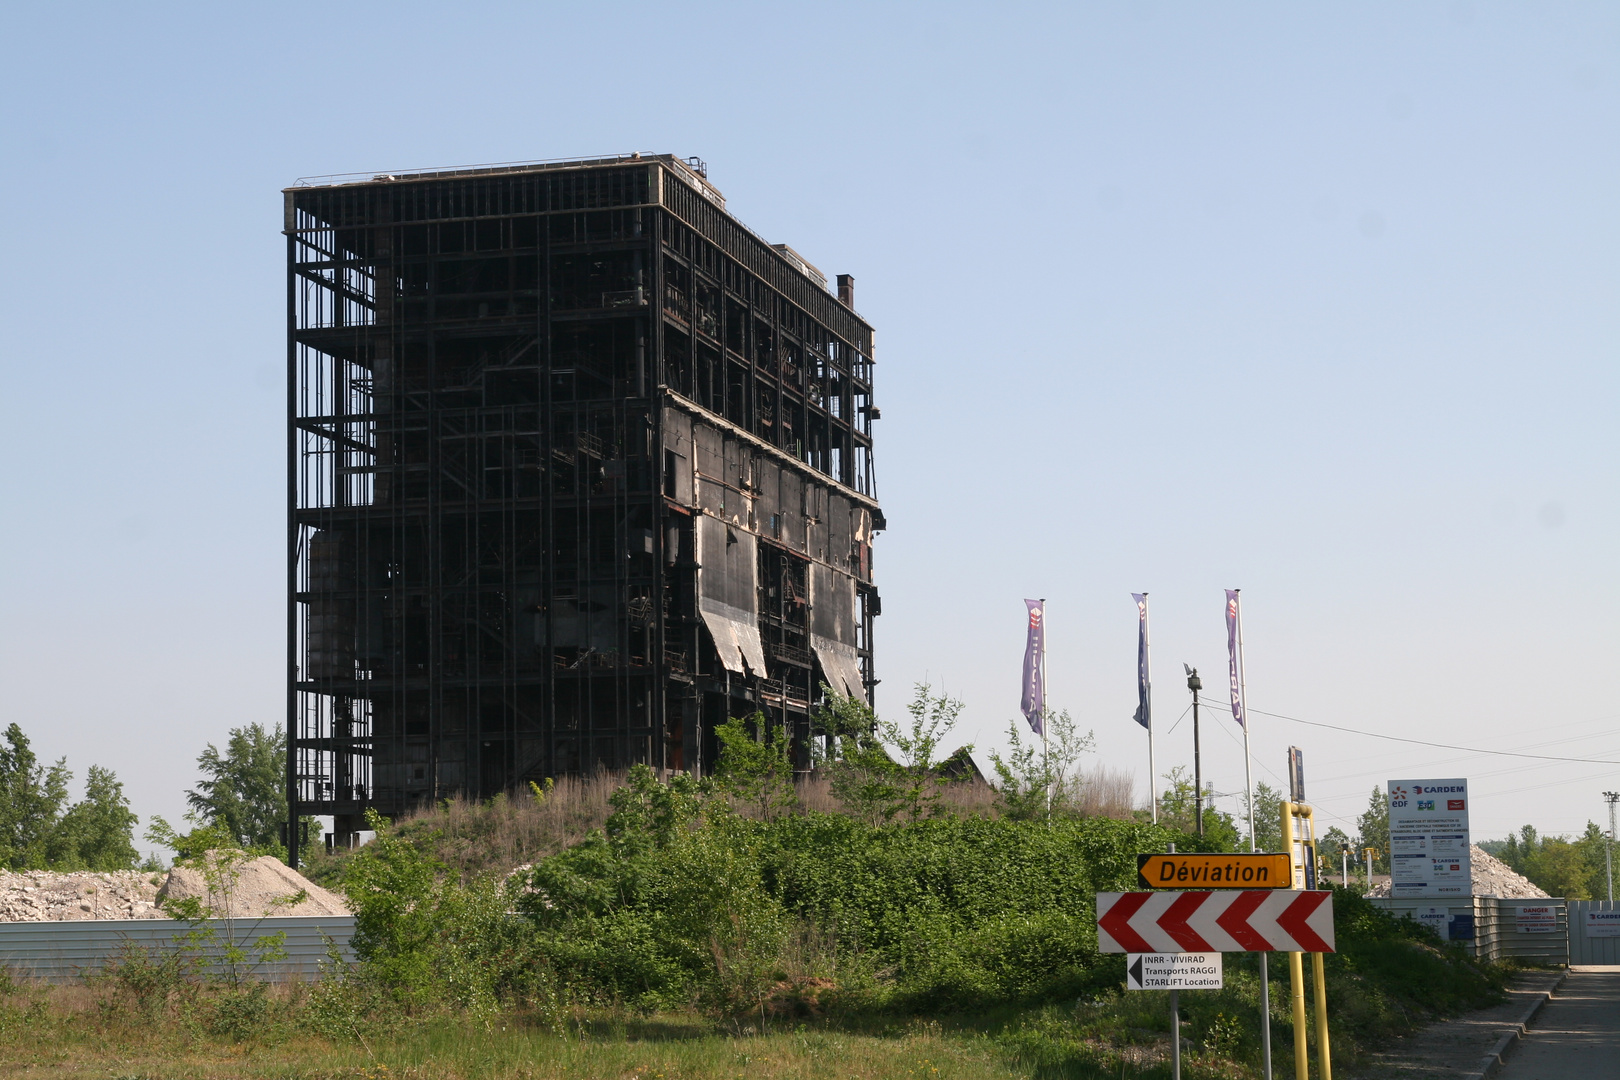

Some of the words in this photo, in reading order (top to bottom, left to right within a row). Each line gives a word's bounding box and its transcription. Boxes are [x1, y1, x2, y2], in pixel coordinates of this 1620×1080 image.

[1159, 860, 1269, 882] Déviation
[1144, 956, 1165, 964] INRR
[1170, 956, 1206, 964] VIVIRAD
[1145, 967, 1189, 976] Transports
[1190, 966, 1217, 975] RAGGI
[1145, 978, 1183, 987] STARLIFT
[1184, 978, 1220, 986] Location
